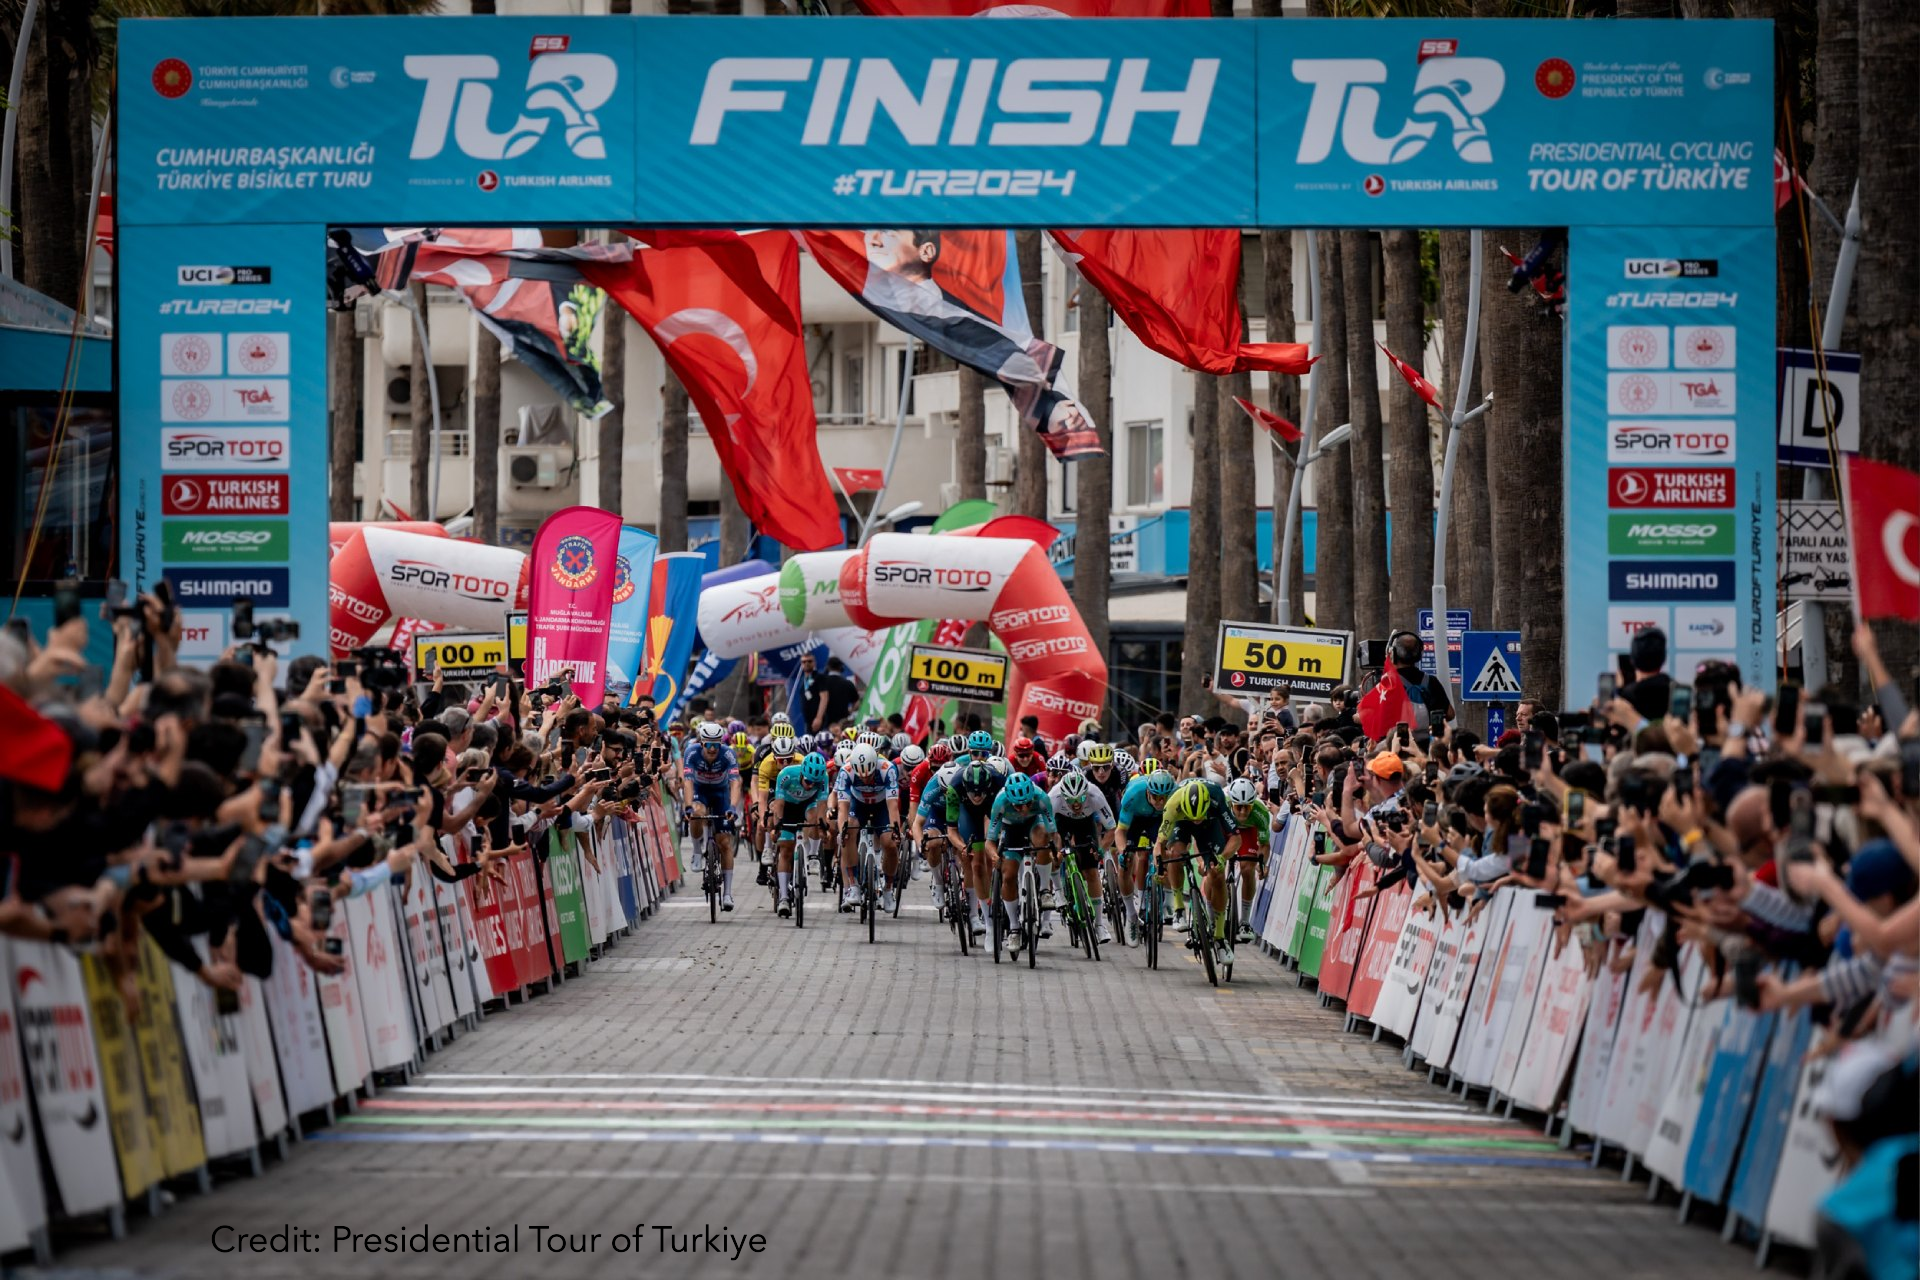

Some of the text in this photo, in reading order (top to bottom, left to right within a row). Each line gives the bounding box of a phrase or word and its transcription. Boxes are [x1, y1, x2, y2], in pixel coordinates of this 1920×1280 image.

[199, 64, 308, 77] TÜRKİYE CUMHURİYETİ
[198, 77, 308, 90] CUMHURBAŞKANLIĞI
[1582, 73, 1684, 84] PRESIDENCY OF THE
[1582, 85, 1684, 97] REPUBLIC OF TÜRKİYE
[403, 53, 618, 160] TUR
[688, 57, 1222, 146] FINISH
[1291, 57, 1506, 165] TUR
[156, 142, 376, 169] CUMHURBAŞKANLIĞI
[1529, 141, 1753, 162] PRESIDENTIAL CYCLING
[157, 168, 372, 190] TÜRKİYE BİSİKLET TURU
[504, 175, 612, 187] TURKISH AIRLINES
[832, 169, 1076, 196] #TUR2024
[1527, 161, 1751, 191] TOUR OF TÜRKİYE
[1390, 179, 1498, 191] TURKISH AIRLINES
[181, 269, 212, 282] UCI
[1628, 262, 1660, 275] UCI
[159, 299, 292, 314] #TUR2024
[1605, 292, 1738, 307] #TUR2024
[1802, 377, 1845, 438] D
[207, 480, 280, 495] TURKISH
[1653, 473, 1727, 488] TURKISH
[206, 495, 281, 510] AIRLINES
[1653, 488, 1727, 503] AIRLINES
[181, 531, 272, 545] MOSSO
[1627, 524, 1718, 538] MOSSO
[1825, 552, 1849, 563] YAS
[551, 567, 598, 588] JANDARMA
[1626, 573, 1719, 589] SHIMANO
[180, 580, 273, 596] SHIMANO
[484, 651, 502, 662] m
[1243, 642, 1322, 673] 50 m
[922, 658, 995, 684] 100 m
[931, 684, 994, 698] TURKISH AIRLINES
[1248, 676, 1331, 691] TURKISH AIRLINES
[1222, 811, 1236, 830] BORA
